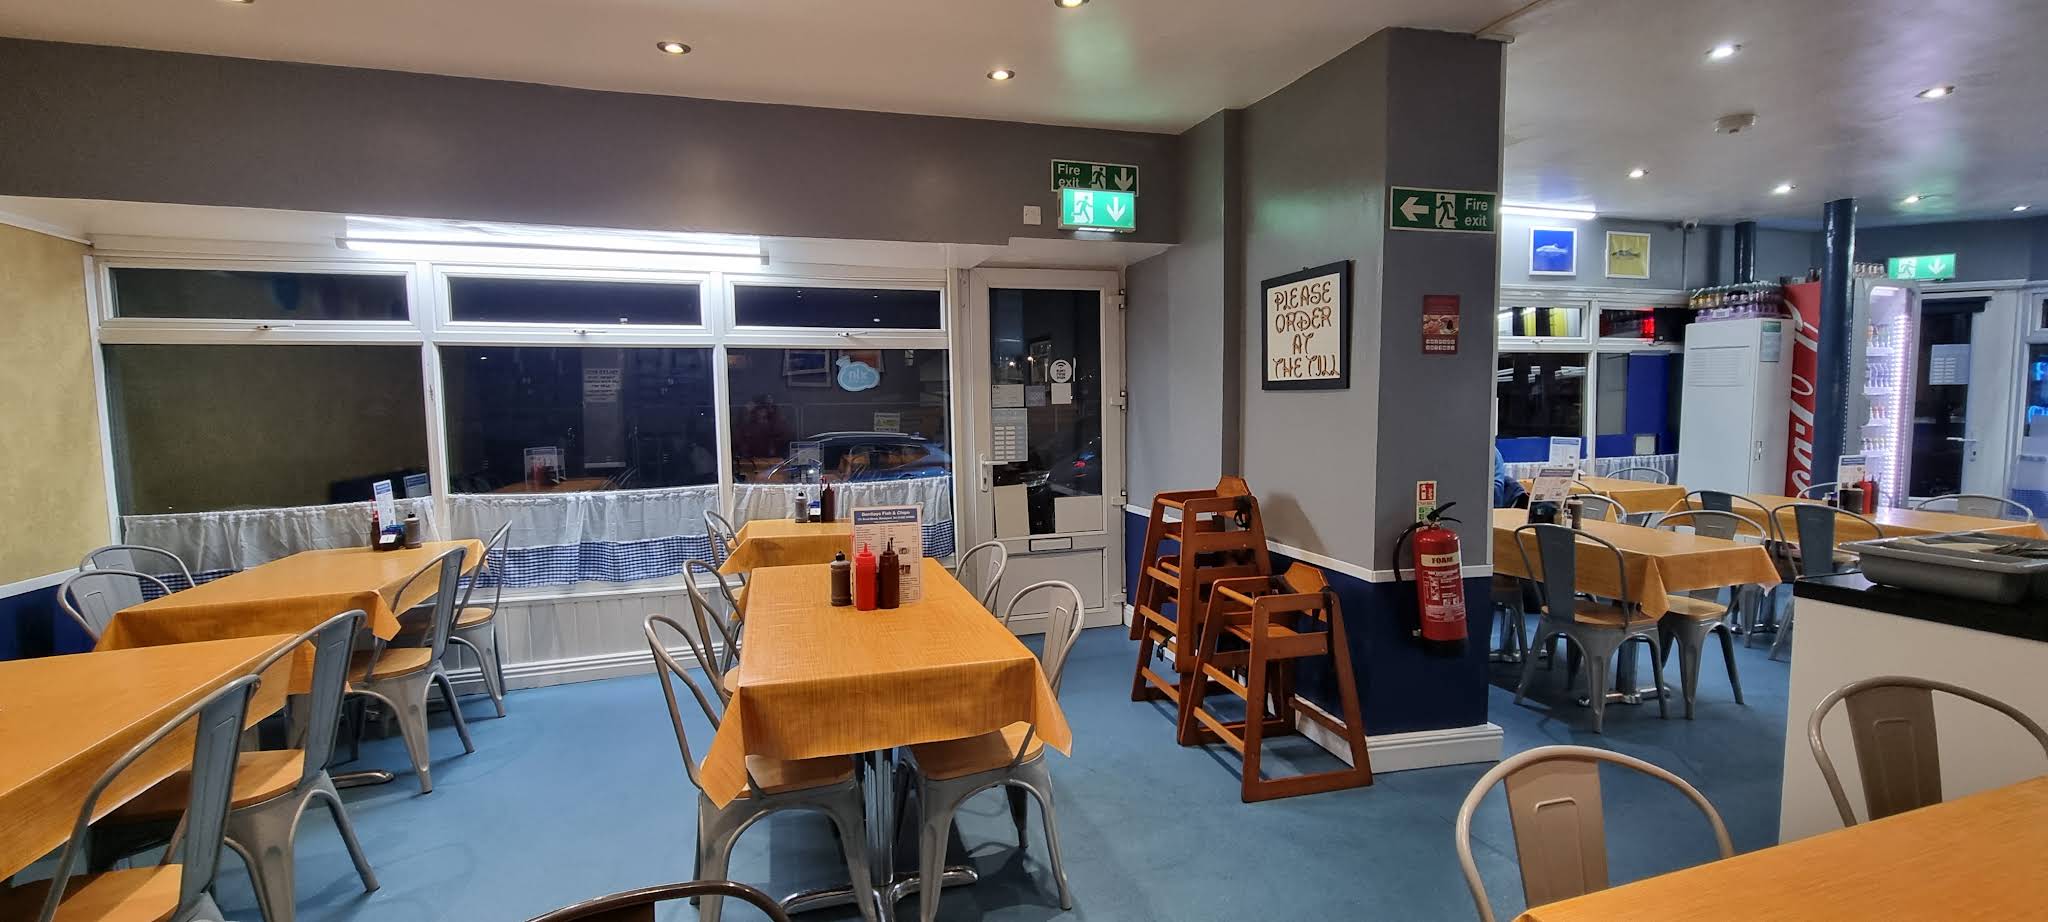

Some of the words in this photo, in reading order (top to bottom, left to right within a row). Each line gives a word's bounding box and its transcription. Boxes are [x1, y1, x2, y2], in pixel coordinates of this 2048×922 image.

[1058, 163, 1080, 175] Fire
[1059, 177, 1079, 188] exit
[1465, 198, 1488, 211] Fire
[1465, 215, 1487, 226] exit
[1274, 281, 1331, 311] PLEASE
[1275, 305, 1331, 333] ORDER
[1292, 332, 1314, 354] AT
[1273, 357, 1302, 378] THE
[1306, 354, 1340, 376] TILL
[1431, 556, 1453, 564] FOAM
